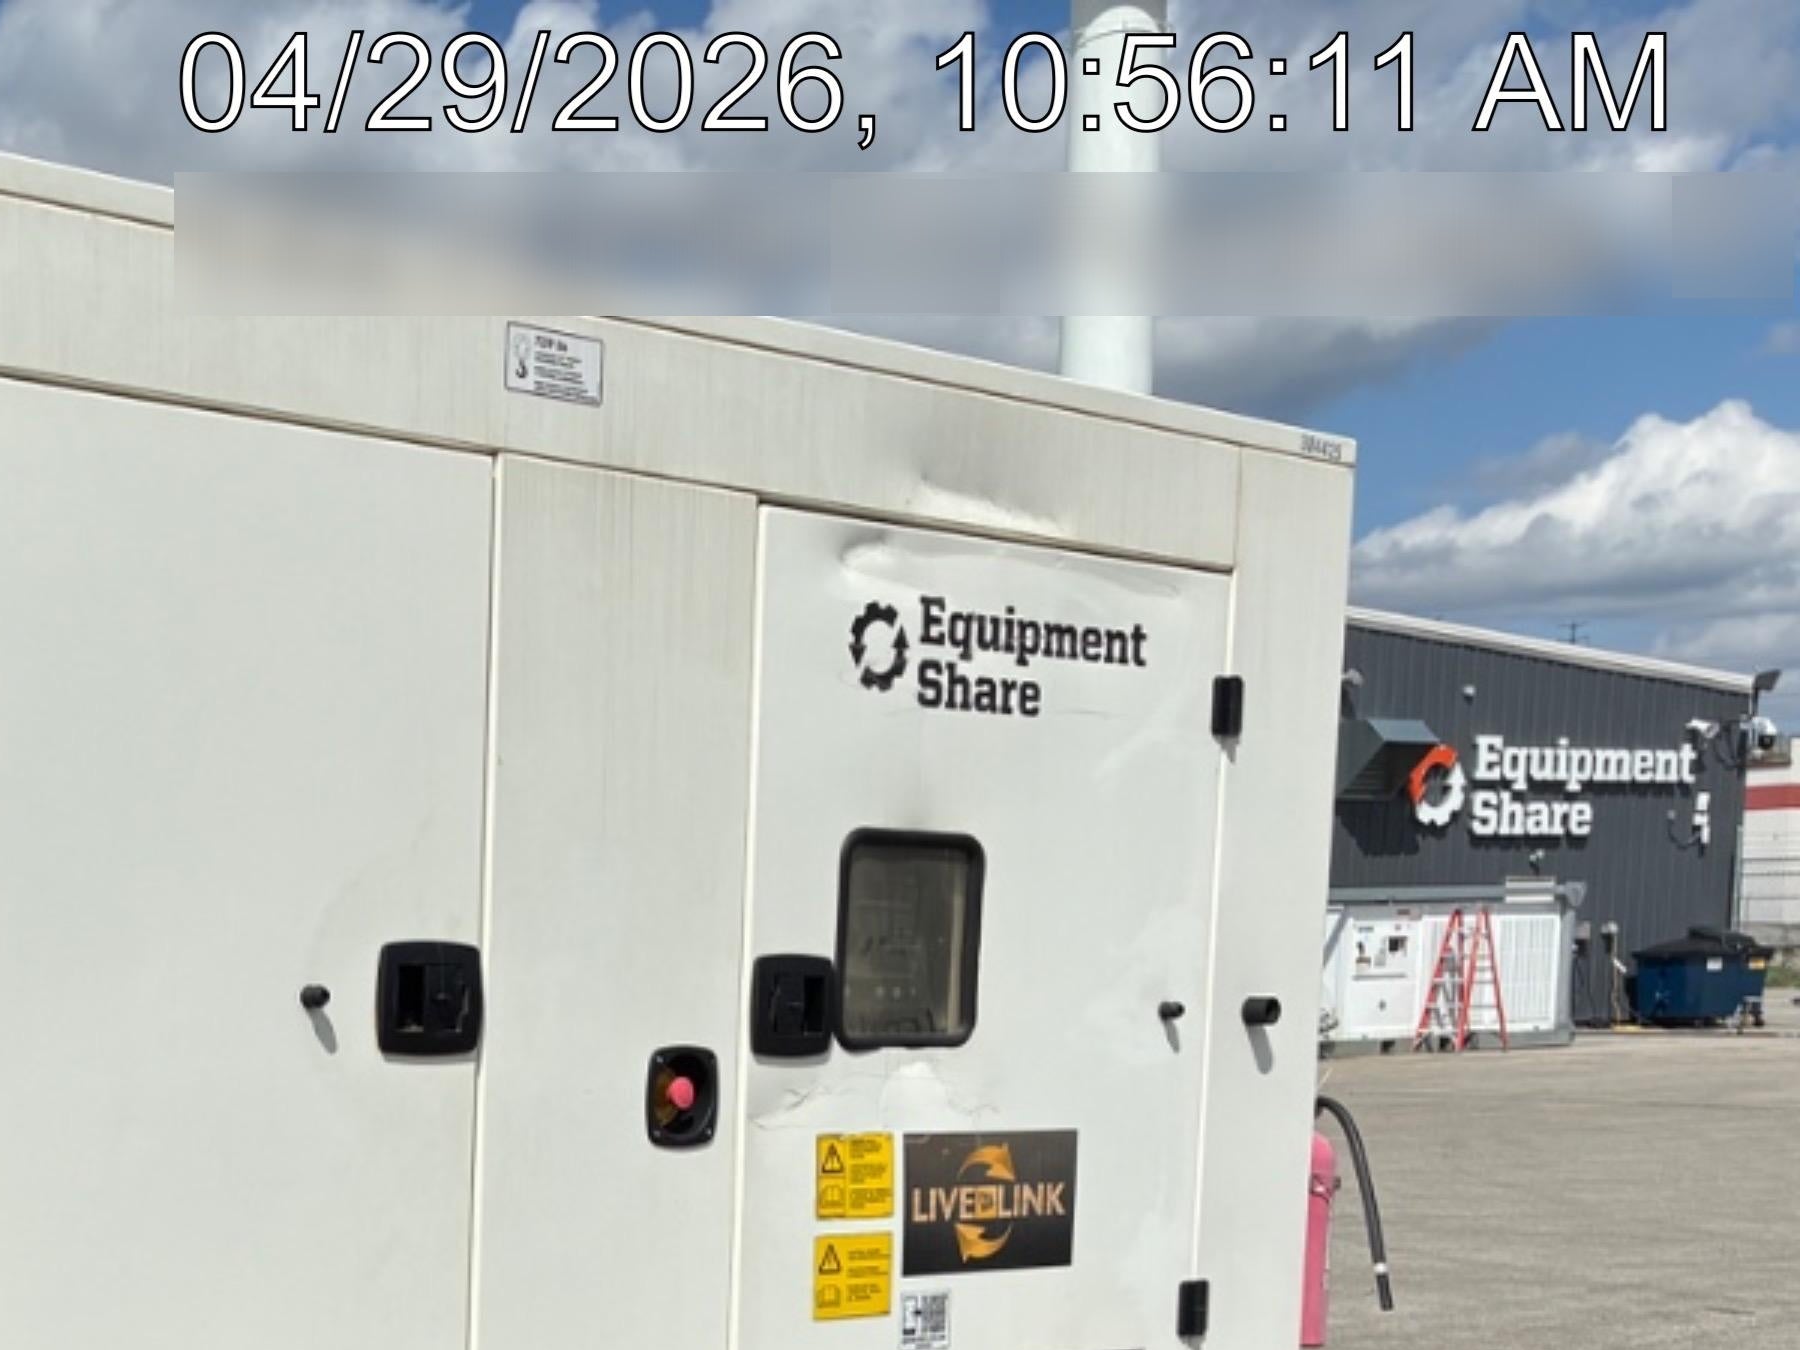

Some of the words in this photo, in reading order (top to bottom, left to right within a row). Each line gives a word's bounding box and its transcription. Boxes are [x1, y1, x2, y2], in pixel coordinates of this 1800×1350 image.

[918, 596, 1147, 668] Equipment
[917, 658, 1041, 718] Share
[1473, 735, 1696, 791] Equipment
[1471, 790, 1593, 837] Share
